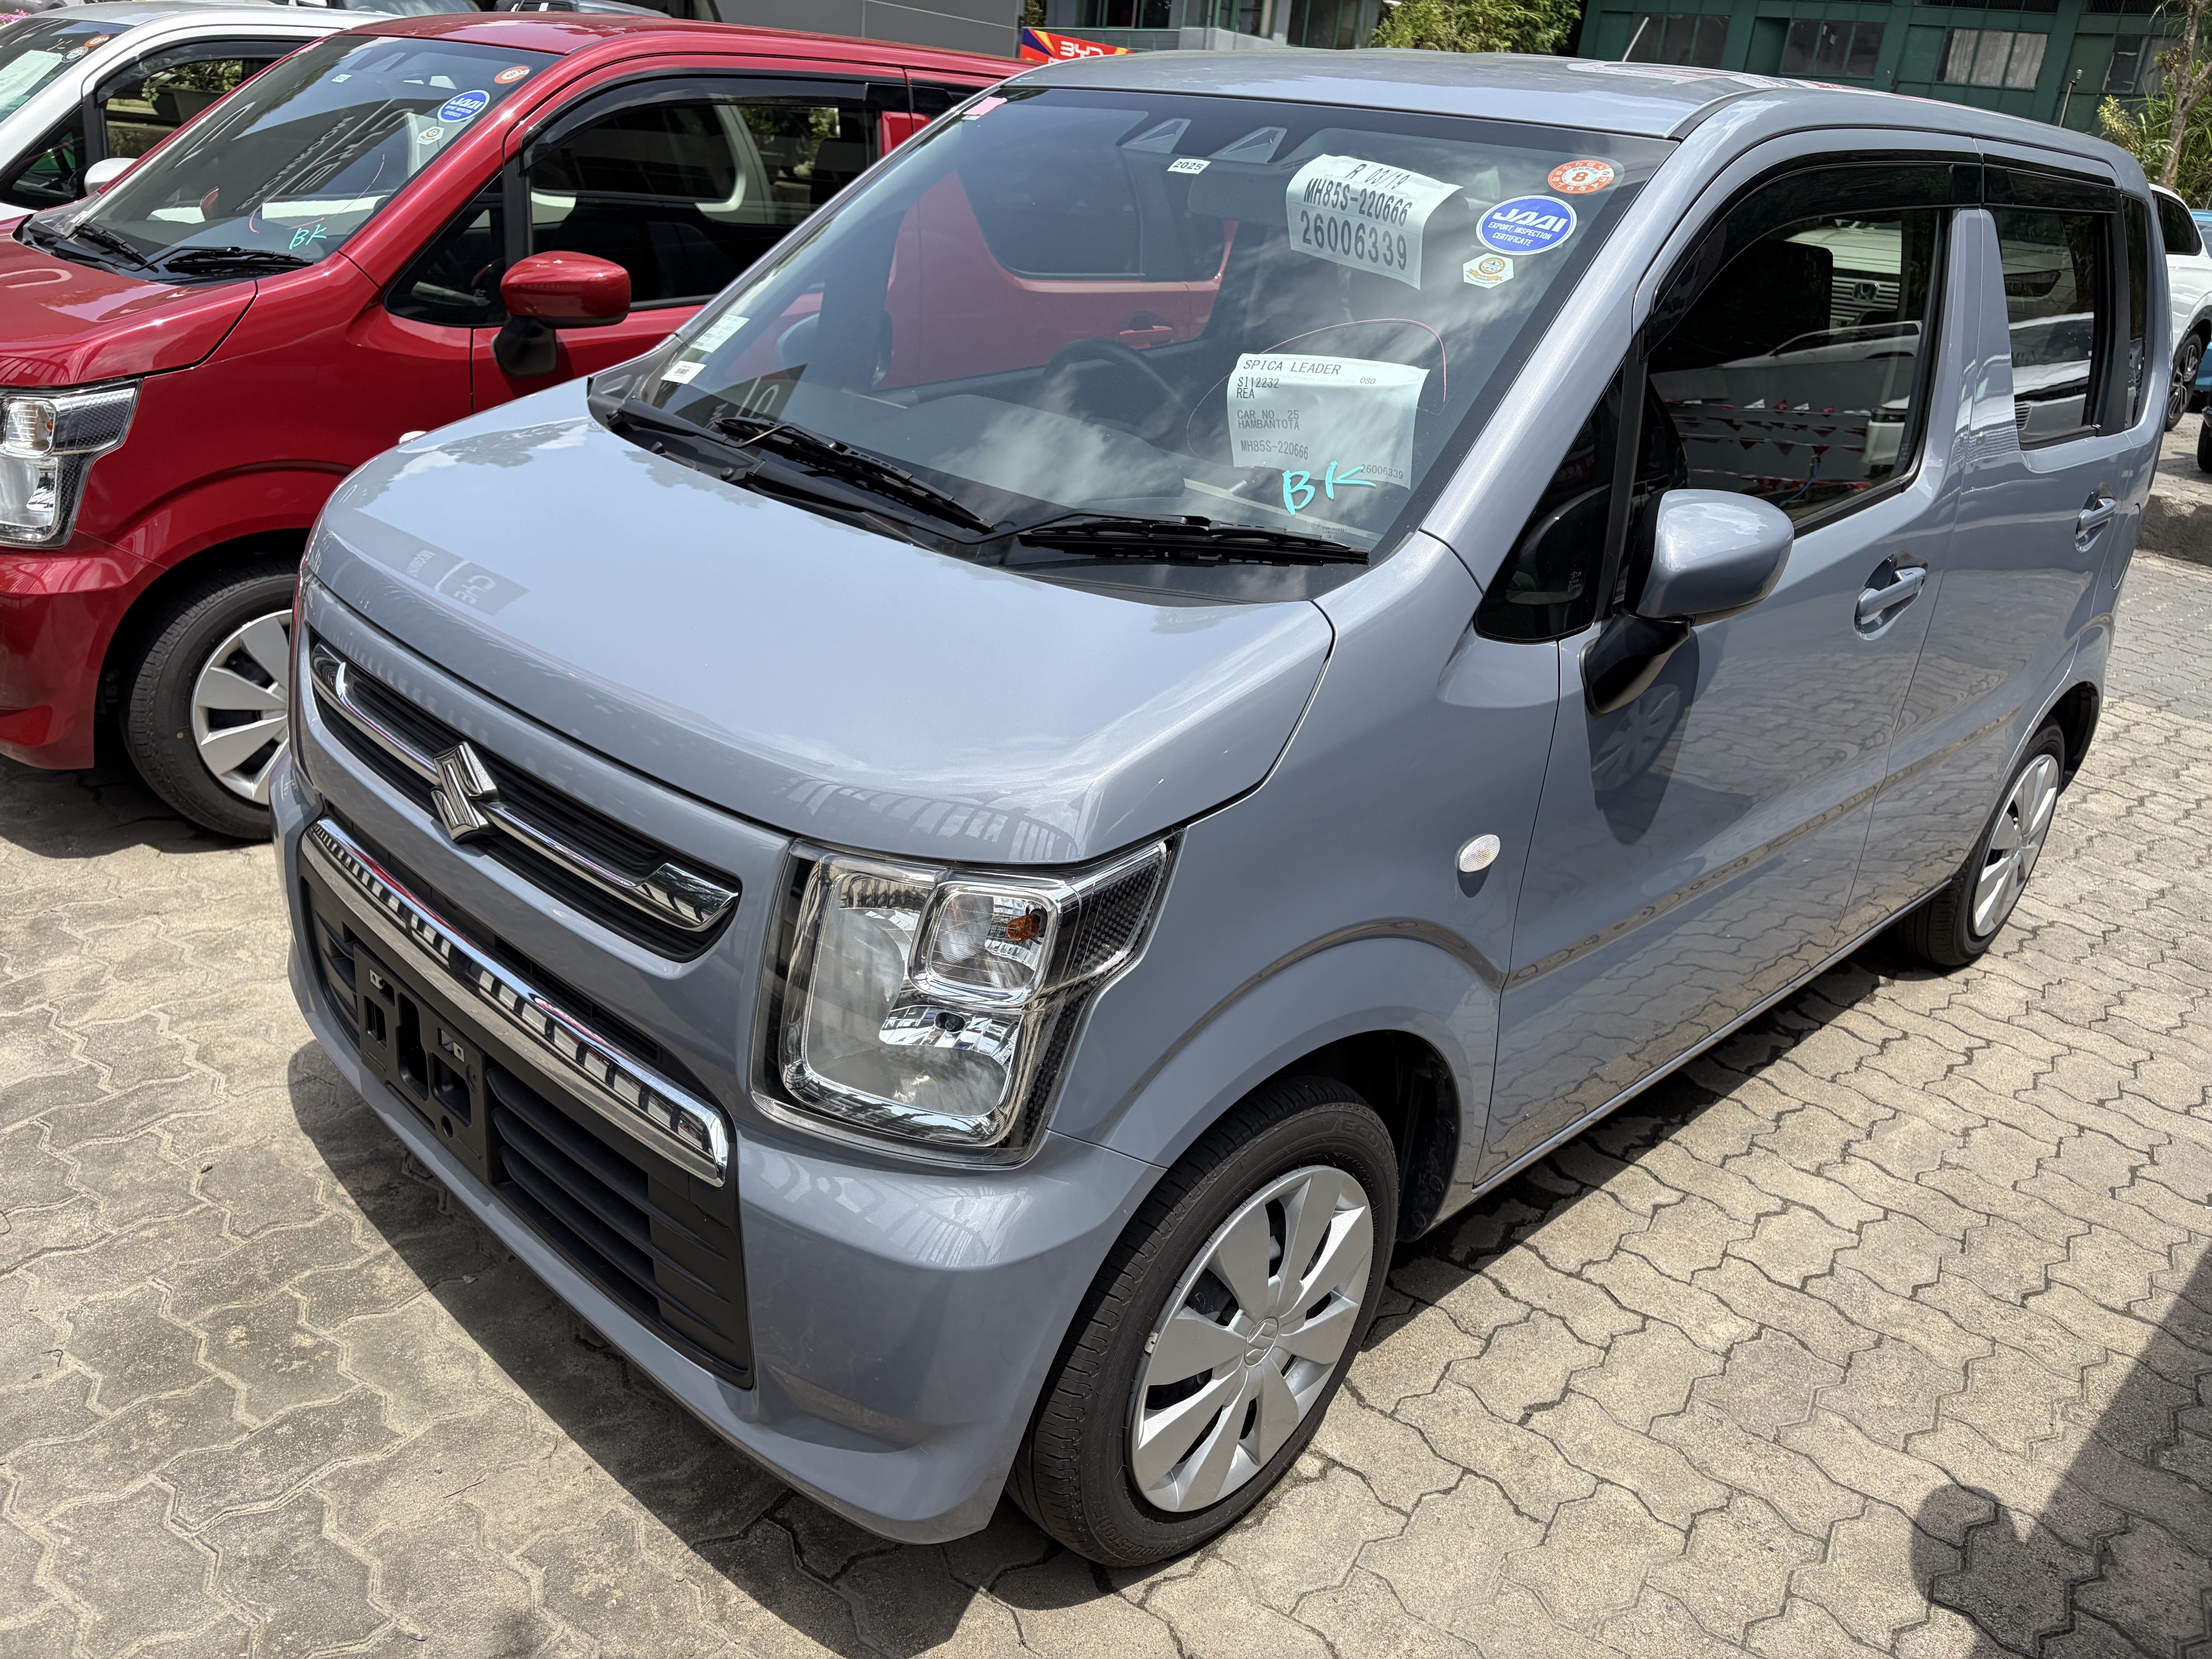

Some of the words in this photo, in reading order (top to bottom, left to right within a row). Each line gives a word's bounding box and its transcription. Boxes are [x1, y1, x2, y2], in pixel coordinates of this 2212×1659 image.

[450, 98, 484, 110] JAAI
[1173, 161, 1204, 170] 2025
[1345, 164, 1367, 179] R
[1364, 168, 1410, 189] 03/19
[1571, 172, 1589, 182] 8
[1304, 178, 1412, 227] MH85S-220666
[1492, 208, 1568, 232] JAAI
[289, 224, 327, 250] BK
[1488, 222, 1514, 232] EXPORT
[1514, 226, 1553, 240] INSPECTION
[1300, 210, 1407, 271] 26006339
[1492, 232, 1533, 247] CERTIFICATE
[1243, 359, 1283, 371] SPICA
[1290, 362, 1341, 375] LEADER
[1237, 376, 1279, 388] SI12232
[1237, 388, 1255, 399] REA
[1237, 410, 1255, 419] CAR
[1262, 410, 1278, 419] NO.
[1287, 410, 1299, 419] 25
[1238, 419, 1300, 431] HAMBANTOTA
[1240, 440, 1308, 460] MH85S-220666
[1360, 464, 1403, 479] 26006339
[1282, 460, 1376, 516] BK
